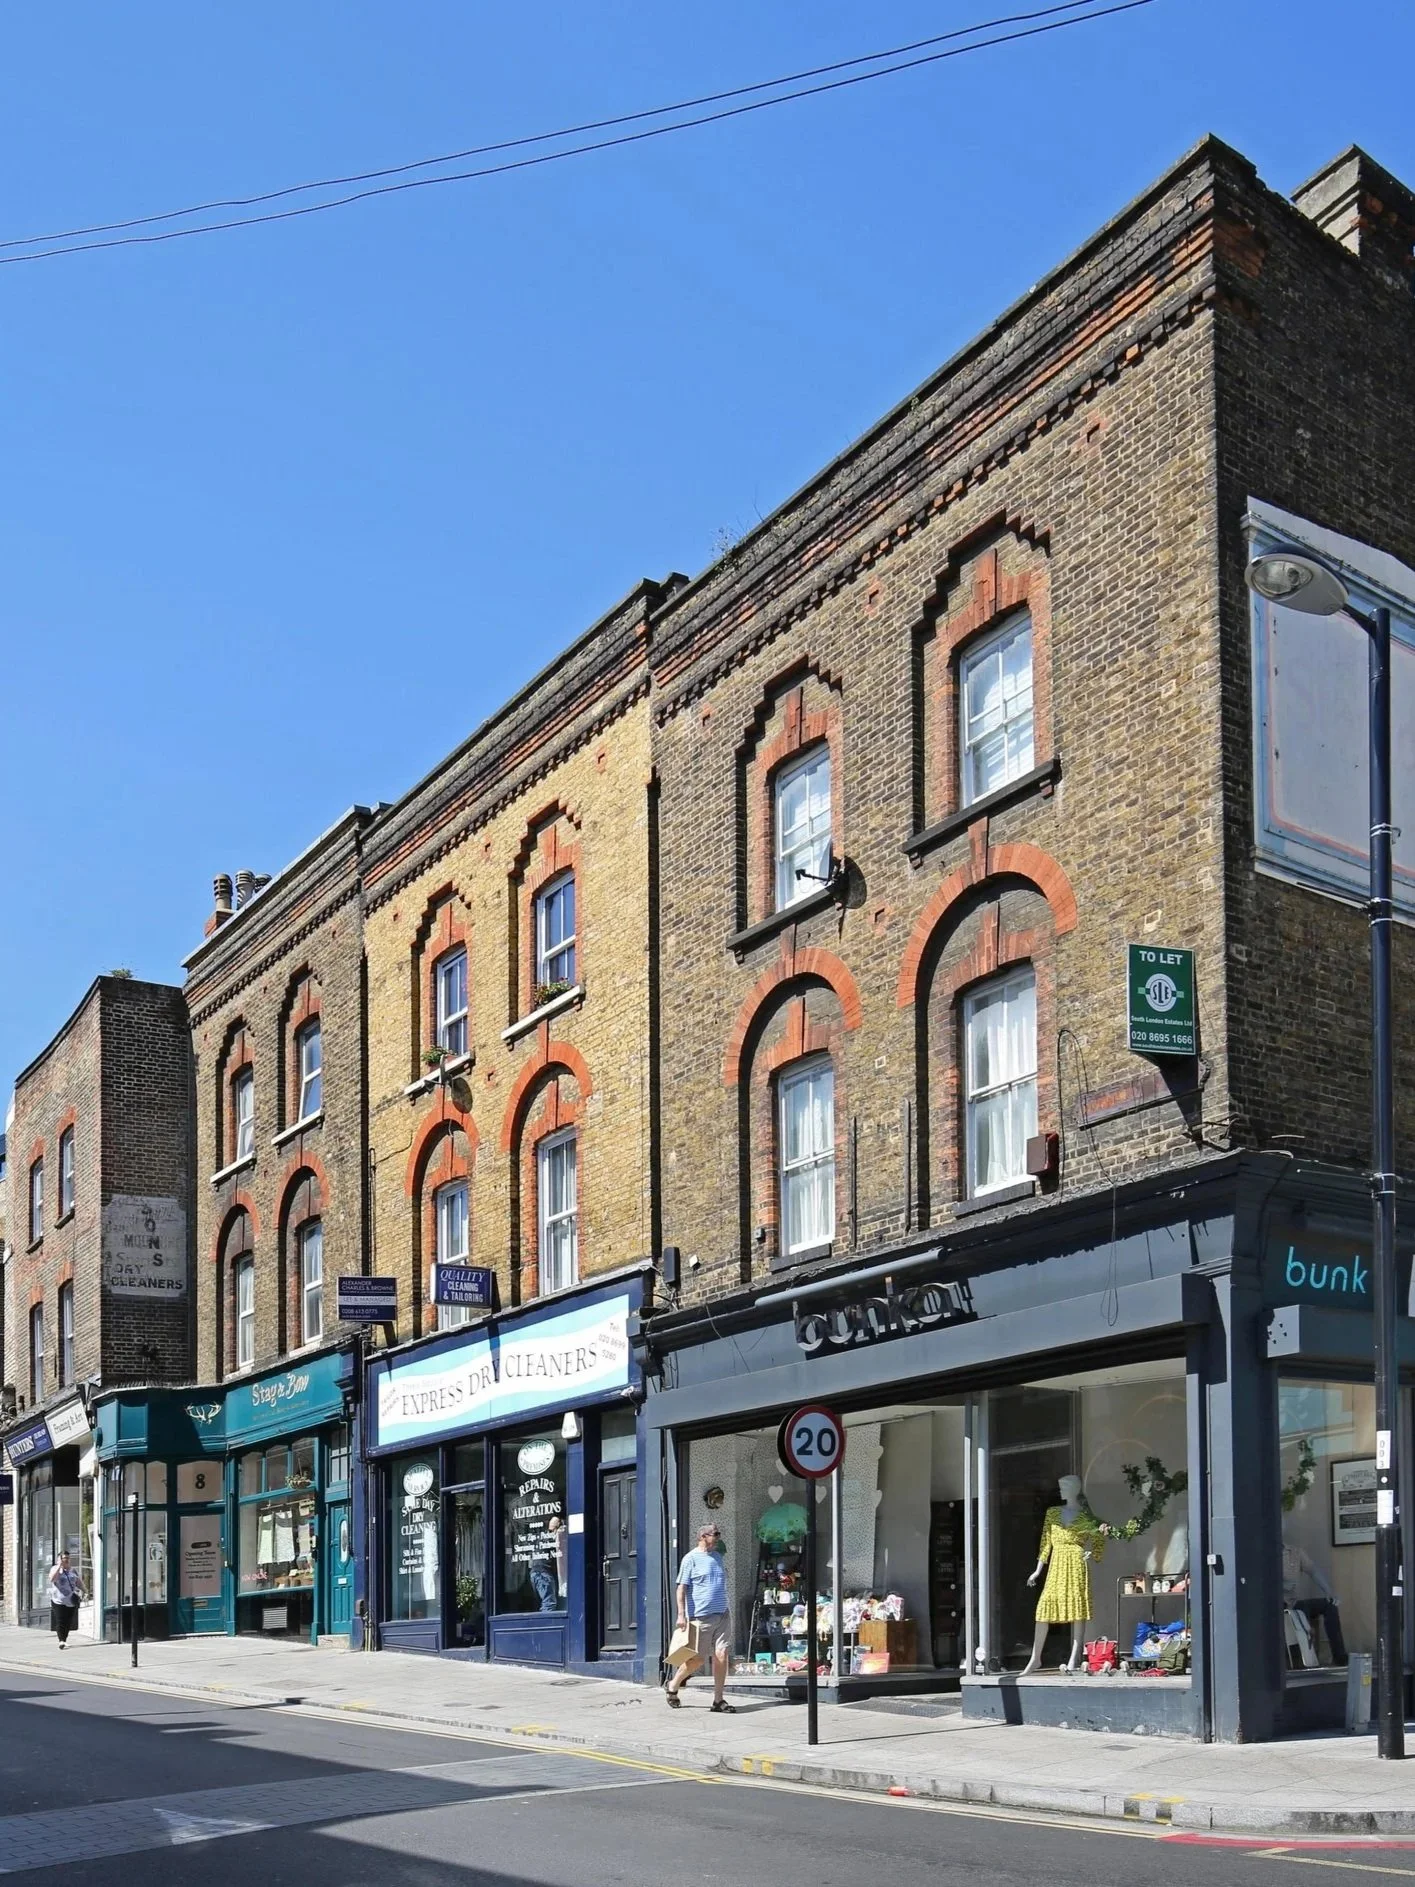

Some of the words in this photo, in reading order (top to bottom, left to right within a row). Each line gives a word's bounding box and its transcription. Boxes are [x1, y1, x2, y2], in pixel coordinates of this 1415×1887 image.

[1139, 951, 1156, 963] TO
[1160, 952, 1183, 965] LET
[1152, 981, 1170, 1004] SLE
[1131, 1015, 1145, 1023] South
[1145, 1016, 1164, 1025] London
[1165, 1018, 1184, 1026] Estates
[1184, 1019, 1193, 1027] Ltd
[1131, 1030, 1147, 1041] 020
[1148, 1031, 1170, 1043] 8695
[1172, 1034, 1193, 1045] 1666
[440, 1269, 485, 1283] QUALITY
[1286, 1246, 1368, 1294] bunk
[111, 1276, 184, 1291] CLEANERS
[447, 1280, 479, 1293] CLEANING
[443, 1290, 449, 1300] &
[450, 1291, 484, 1303] TAILORING
[402, 1380, 463, 1416] EXPRESS
[469, 1358, 500, 1396] DRY
[505, 1342, 598, 1378] CLEANERS
[252, 1383, 278, 1408] Stag
[278, 1382, 286, 1398] &
[285, 1373, 310, 1400] Bow
[795, 1426, 836, 1457] 20
[195, 1473, 206, 1490] 8
[518, 1477, 555, 1498] REPAIRS
[532, 1492, 540, 1504] &
[401, 1498, 421, 1517] SAE
[422, 1497, 435, 1512] DAY
[512, 1501, 562, 1520] ALTERATIONS
[412, 1511, 425, 1524] DRY
[401, 1520, 436, 1536] CLEANING
[518, 1534, 527, 1543] New
[527, 1533, 537, 1542] Zips
